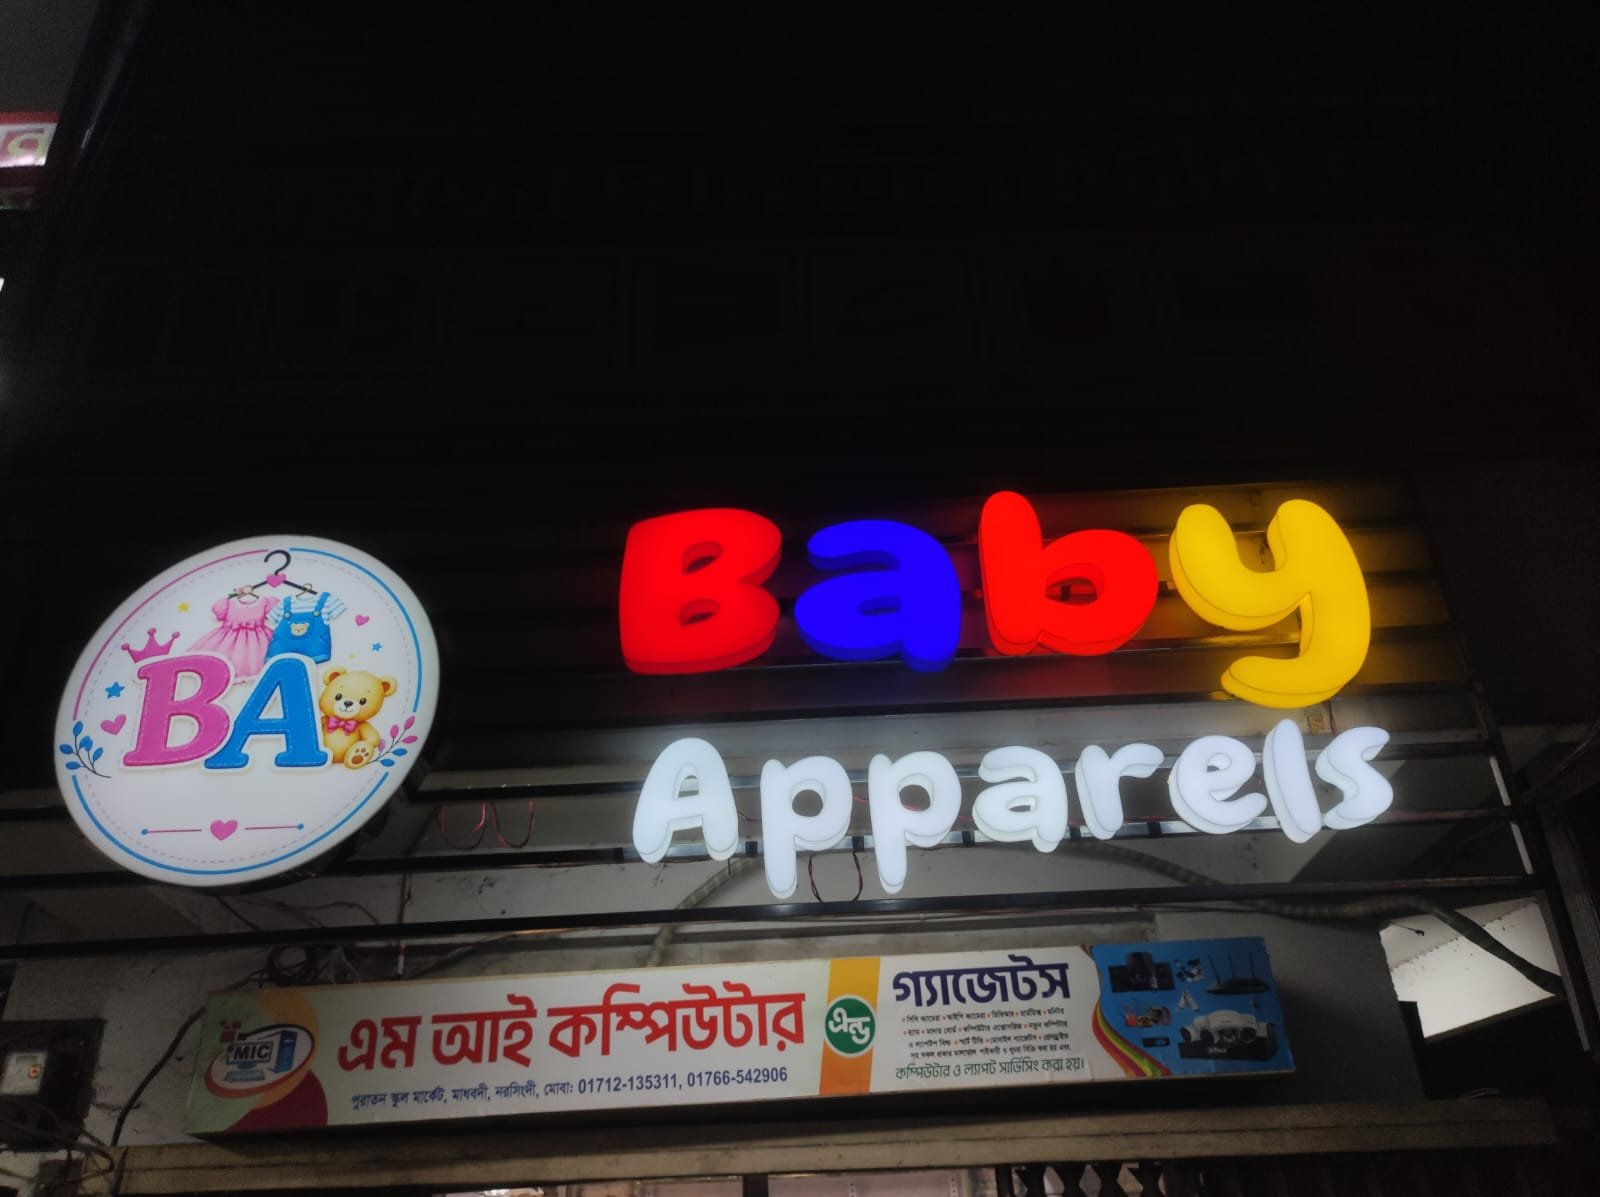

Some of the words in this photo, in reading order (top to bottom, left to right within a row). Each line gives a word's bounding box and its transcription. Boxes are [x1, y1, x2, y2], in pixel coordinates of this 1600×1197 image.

[619, 490, 1371, 708] Baby
[123, 654, 329, 770] BA
[632, 718, 1393, 898] Apparels
[892, 954, 1070, 1007] গ্যাজেটস
[337, 1015, 421, 1071] এম
[431, 993, 537, 1067] আই
[547, 981, 806, 1057] কম্পিউটার
[828, 1007, 871, 1044] এন্ড
[233, 1044, 270, 1061] MIC
[895, 1062, 950, 1080] কম্পিউটার
[952, 1064, 961, 1077] ও
[998, 1056, 1040, 1074] সার্ভিসিং
[1041, 1058, 1064, 1072] করা
[577, 1072, 683, 1096] 01712-135311,
[686, 1066, 788, 1088] 01766-542906
